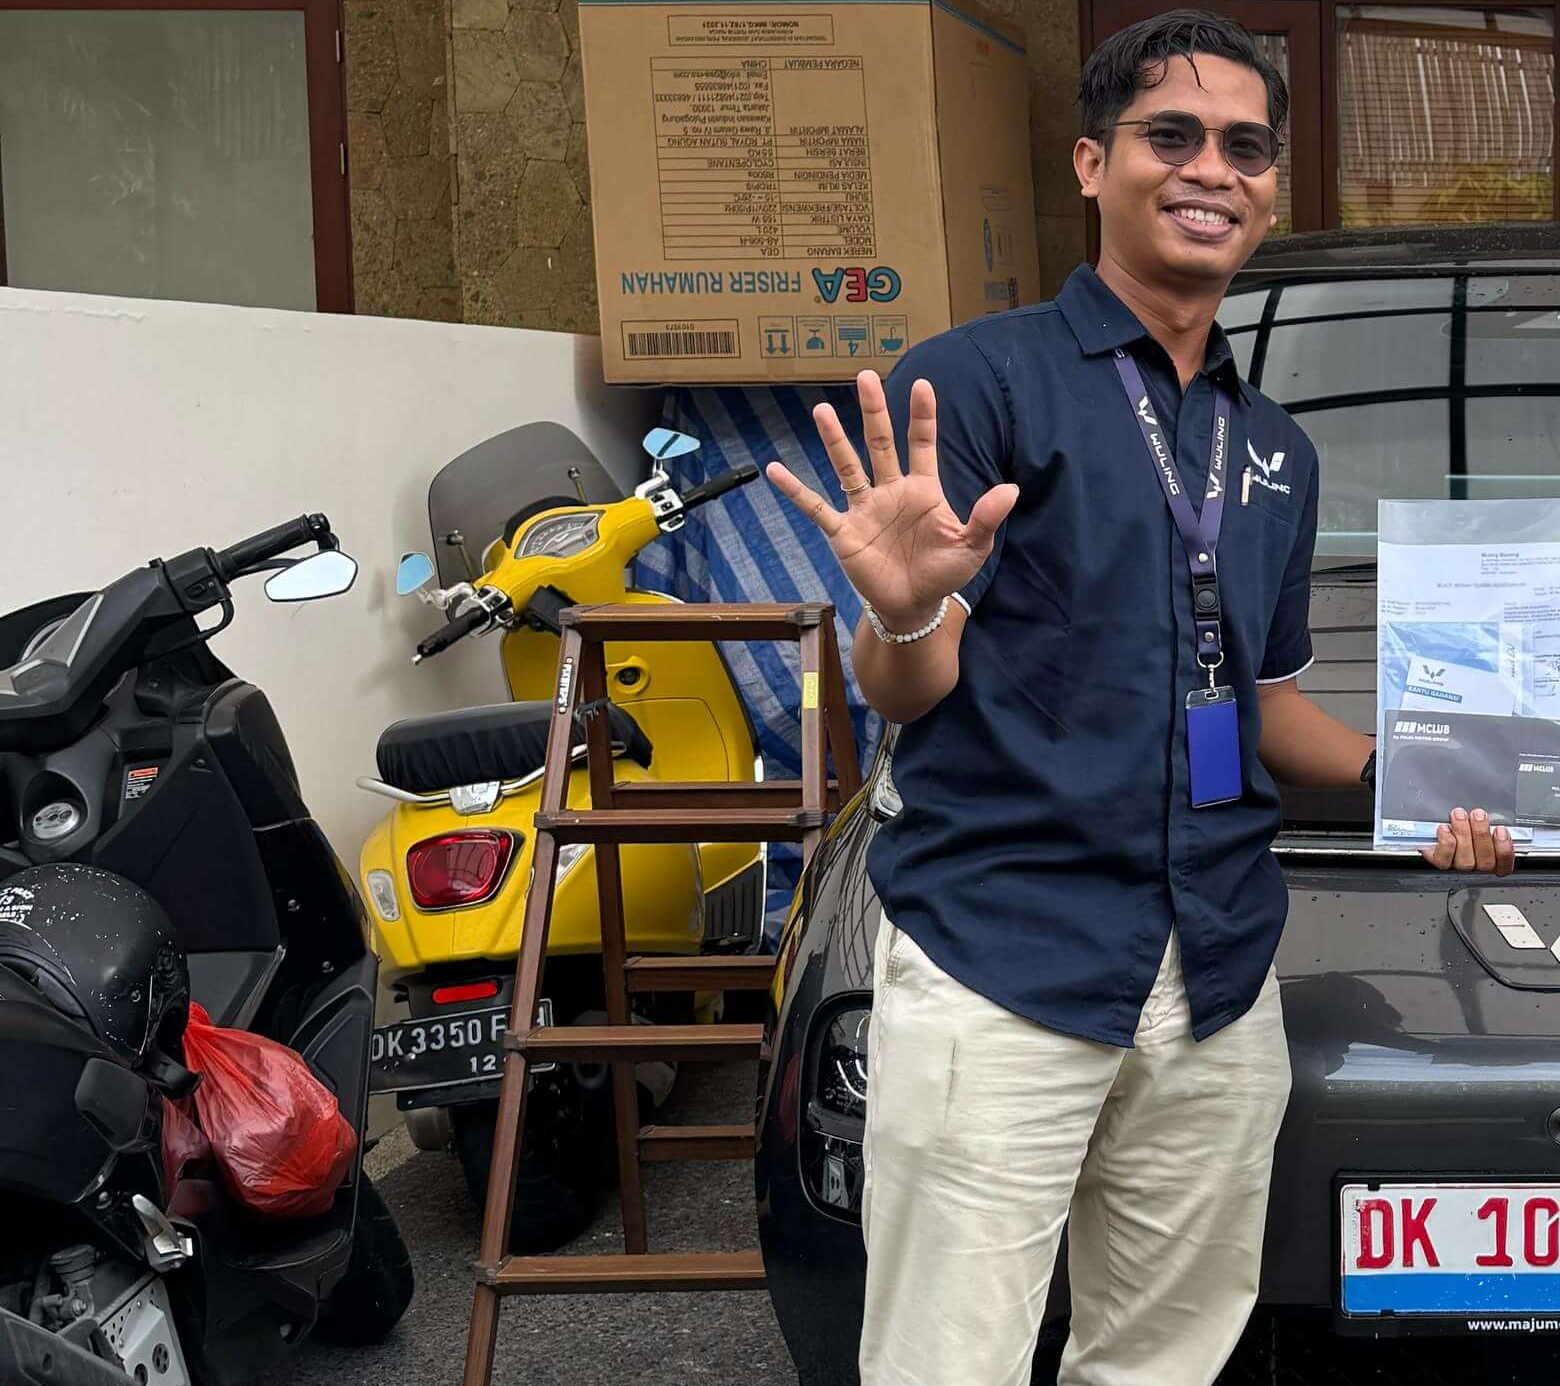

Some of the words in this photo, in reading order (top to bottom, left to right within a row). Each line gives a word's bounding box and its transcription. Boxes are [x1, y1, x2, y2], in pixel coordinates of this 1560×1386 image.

[741, 60, 767, 68] CHINA
[784, 59, 823, 68] PEMBUAT
[825, 59, 859, 68] NEGARA
[720, 104, 741, 112] Timur
[743, 104, 770, 112] Jakarta
[831, 125, 864, 134] ALAMAT
[729, 137, 758, 145] ROYAL
[841, 137, 864, 145] NAMA
[806, 148, 836, 156] BERSIH
[838, 148, 865, 156] BERAT
[841, 171, 867, 179] MEDIA
[841, 182, 868, 190] KELAS
[846, 215, 870, 223] DAYA
[837, 226, 870, 234] VOLUME
[843, 236, 871, 244] MODEL
[760, 248, 779, 256] GEA
[807, 248, 841, 256] BARANG
[842, 247, 872, 256] MEREK
[621, 271, 723, 295] RUMAHAN
[730, 271, 801, 293] FRISER
[812, 266, 901, 304] GEA
[1215, 416, 1226, 471] WULING
[1150, 432, 1181, 496] WULING
[1416, 722, 1450, 735] MCLUB
[371, 1029, 404, 1062] DK
[411, 1018, 482, 1054] 3350
[1356, 1196, 1441, 1269] DK
